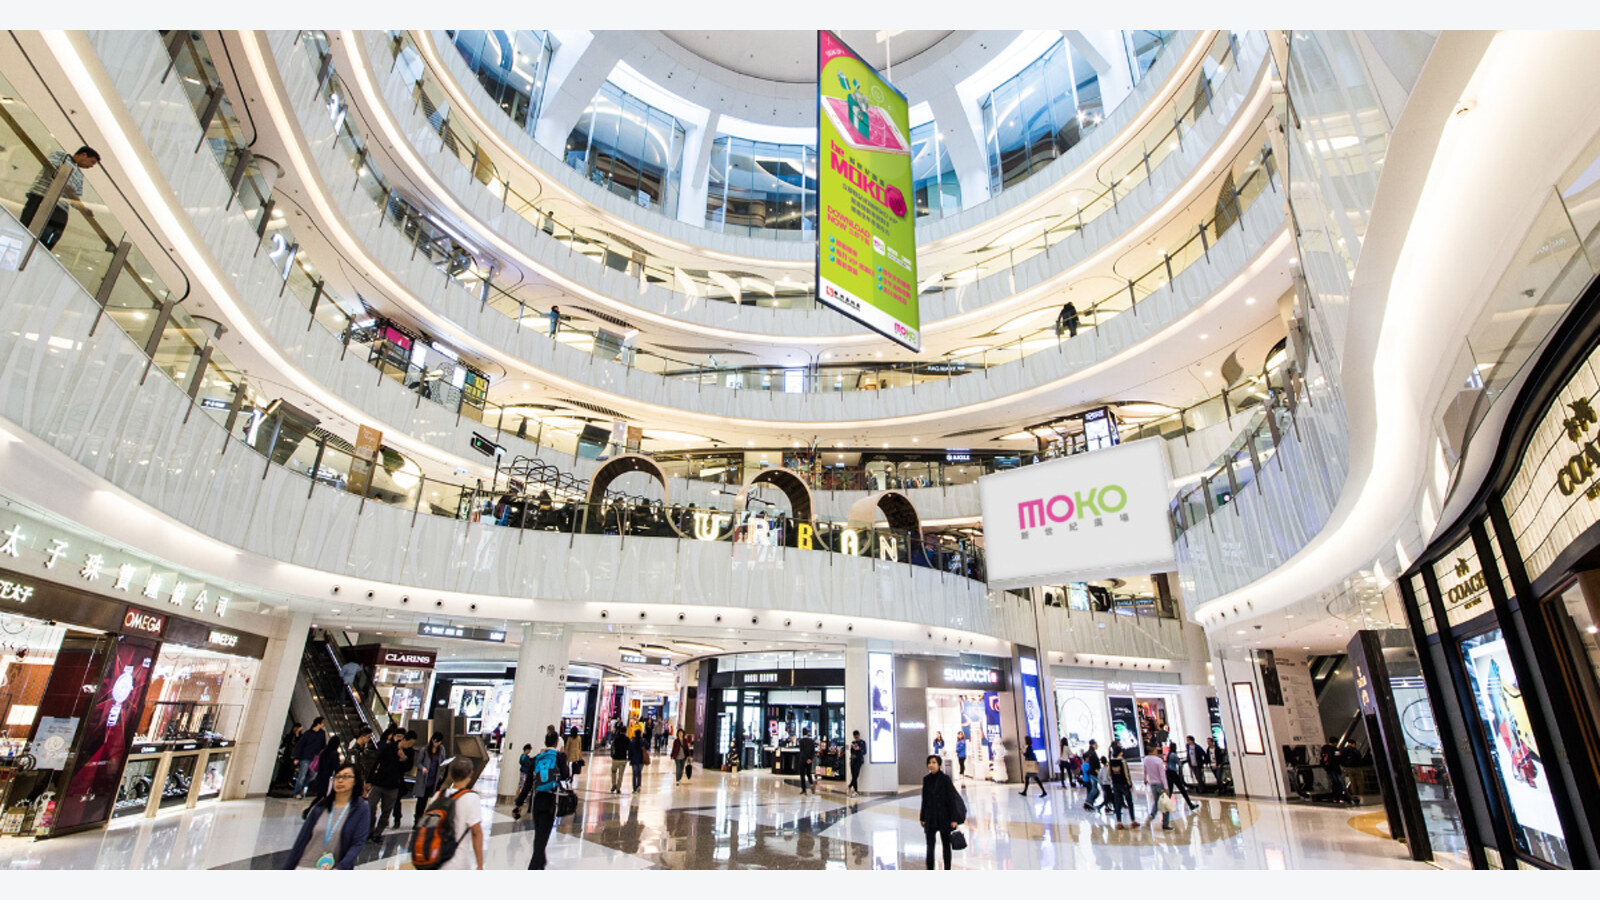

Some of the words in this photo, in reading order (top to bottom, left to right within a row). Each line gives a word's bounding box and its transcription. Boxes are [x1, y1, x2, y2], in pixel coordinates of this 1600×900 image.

[831, 151, 889, 208] MOKO
[827, 205, 870, 238] DOWNLOAD
[827, 213, 847, 231] NOW
[1558, 430, 1600, 496] COA
[1018, 484, 1127, 530] MOKO
[124, 611, 162, 633] OMEGA
[385, 653, 430, 664] CLARINS
[943, 667, 991, 683] swatch
